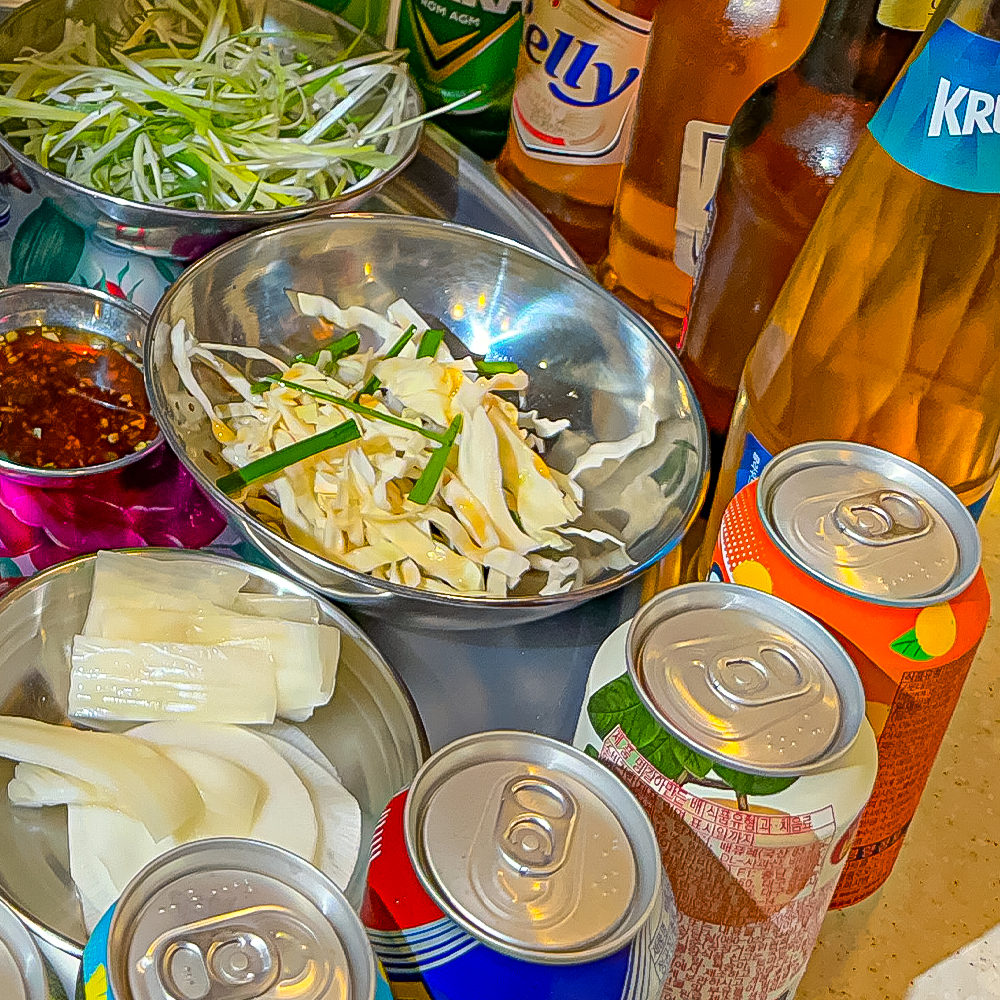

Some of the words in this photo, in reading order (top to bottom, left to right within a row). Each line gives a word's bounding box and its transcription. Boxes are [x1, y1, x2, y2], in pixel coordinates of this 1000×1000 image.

[449, 10, 481, 28] AGM
[525, 12, 641, 108] elly
[641, 764, 688, 807] 갈아만든
[690, 797, 702, 815] 배
[706, 804, 755, 833] 식품유형
